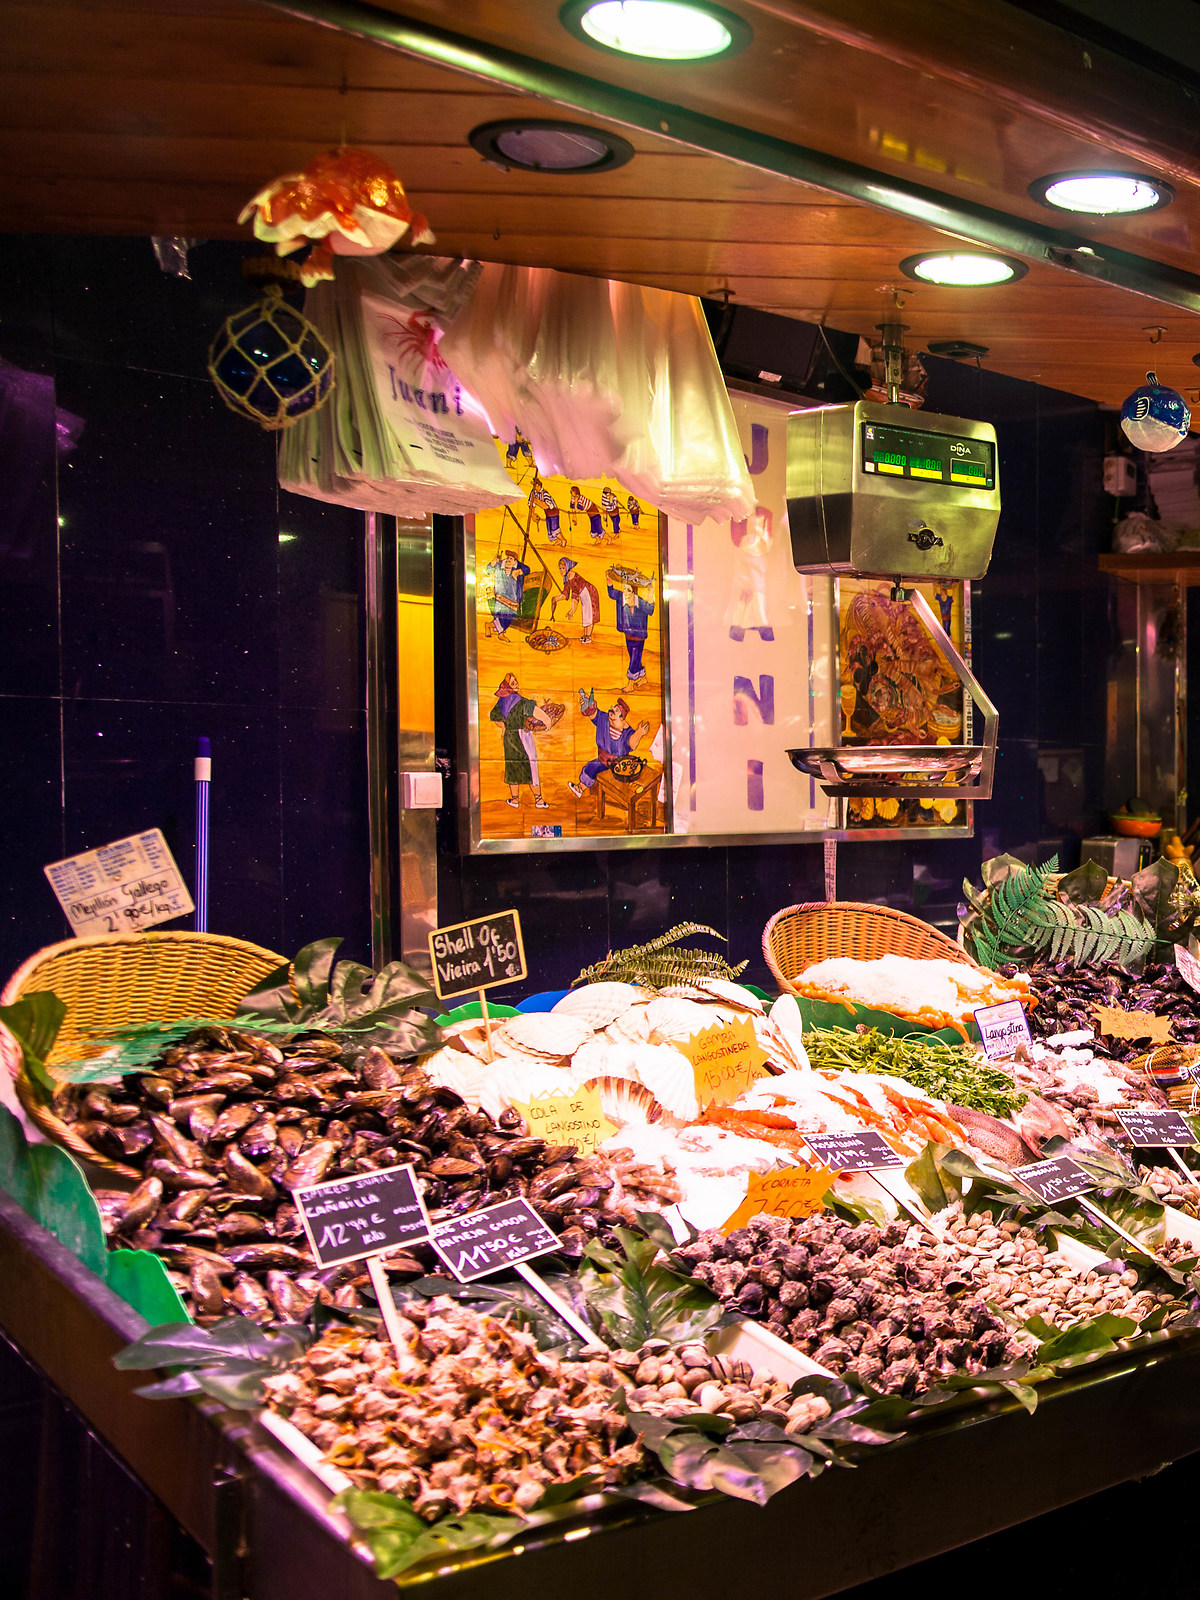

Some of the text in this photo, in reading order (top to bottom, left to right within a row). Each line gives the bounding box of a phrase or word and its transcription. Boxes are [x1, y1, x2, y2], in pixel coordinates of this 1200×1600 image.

[387, 364, 464, 416] Juani
[950, 443, 972, 456] DINA
[434, 924, 501, 959] Shell Of
[437, 960, 481, 982] Vieira
[699, 1030, 737, 1050] GAMBA
[692, 1041, 751, 1066] LANGOSTINERA
[530, 1101, 585, 1120] COLA DE
[545, 1119, 601, 1135] LANGOSTINO
[761, 1178, 811, 1192] CORNETA
